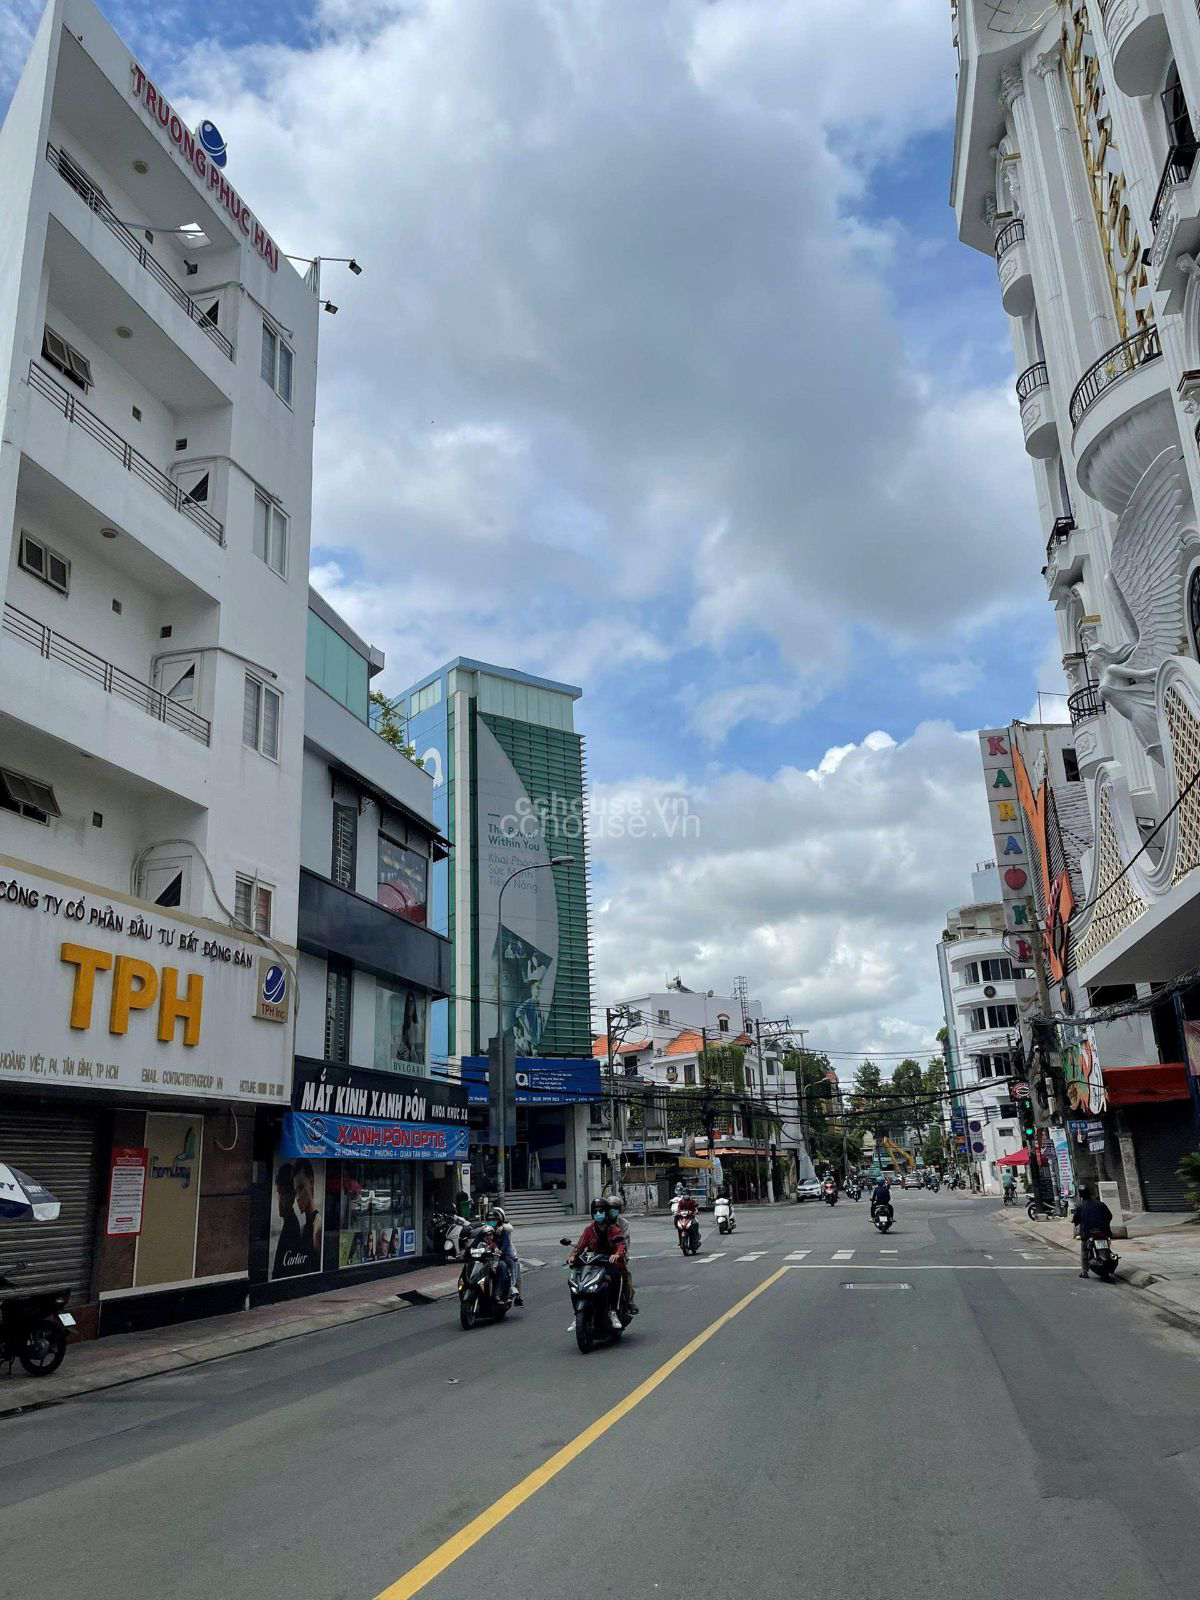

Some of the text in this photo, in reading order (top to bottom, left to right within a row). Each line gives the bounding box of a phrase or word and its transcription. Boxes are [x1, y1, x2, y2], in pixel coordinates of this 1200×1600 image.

[209, 164, 251, 236] PHUC
[253, 220, 280, 273] HAI
[488, 834, 540, 851] Within You
[0, 879, 39, 908] CÔNG
[43, 894, 63, 916] TY
[65, 896, 85, 921] CỔ
[88, 905, 124, 932] PHẦN
[127, 914, 153, 941] ĐẦU
[158, 928, 176, 947] TƯ
[177, 930, 200, 953] BẤT
[201, 940, 231, 963] ĐỘNG
[60, 942, 204, 1047] TPH
[261, 1003, 286, 1019] TPH Inc
[393, 1061, 424, 1076] BVLGARI
[334, 1077, 368, 1115] KÍNH
[369, 1090, 403, 1119] XANH
[404, 1088, 427, 1121] PÔN
[335, 1124, 447, 1149] XANH PÔN OPTIC
[283, 1250, 307, 1266] Cartier
